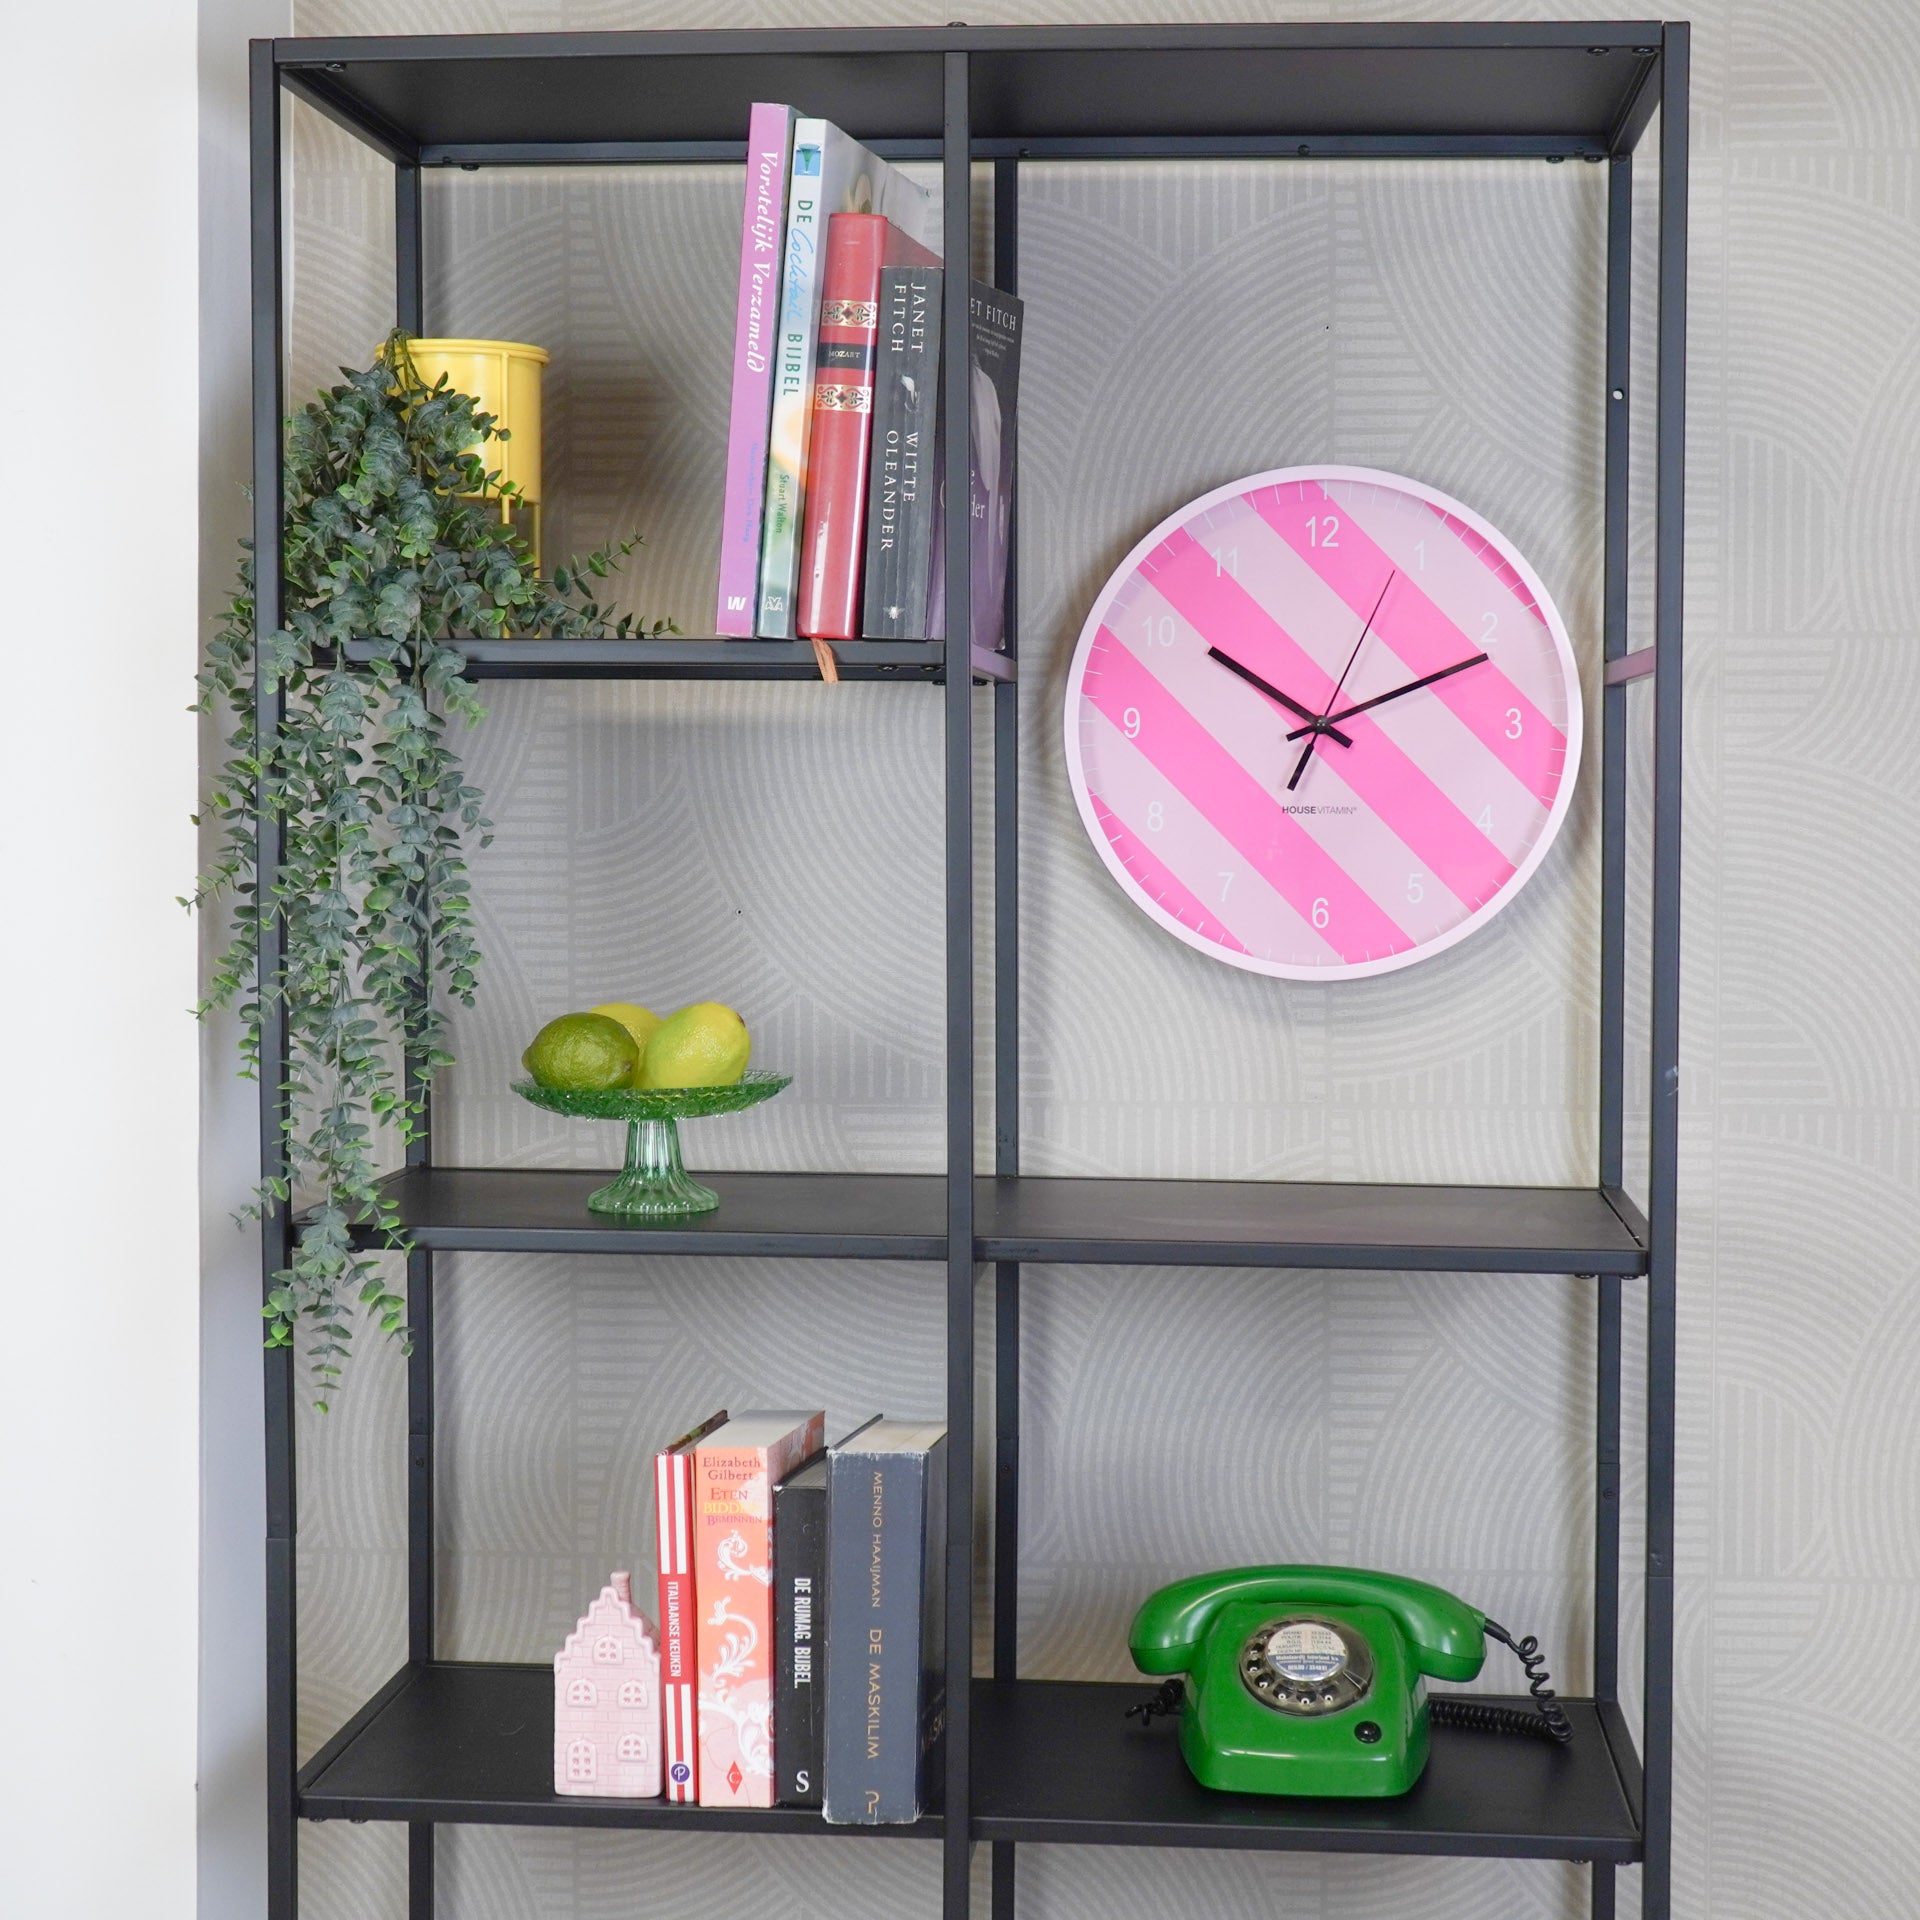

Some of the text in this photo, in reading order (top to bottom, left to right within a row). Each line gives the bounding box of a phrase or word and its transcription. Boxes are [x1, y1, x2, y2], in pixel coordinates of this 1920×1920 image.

[751, 152, 778, 252] Vorstelijk
[796, 200, 813, 223] DE
[891, 284, 907, 352] FITCH
[911, 282, 926, 353] JANET
[986, 304, 1017, 331] FITCH
[783, 333, 803, 396] BIJBEL
[828, 350, 861, 359] MOZART
[903, 431, 919, 502] WITTE
[775, 474, 790, 533] Stuart Walton
[880, 430, 899, 551] OLEANDER
[1305, 516, 1340, 548] 12
[1210, 545, 1238, 578] 11
[1413, 540, 1424, 571] 1
[1142, 616, 1176, 648] 10
[1481, 612, 1499, 643] 2
[1123, 707, 1141, 739] 9
[1505, 708, 1523, 740] 3
[1147, 801, 1164, 832] 8
[1476, 803, 1493, 835] 4
[1218, 871, 1235, 902] 7
[1406, 873, 1424, 904] 5
[1312, 897, 1329, 929] 6
[703, 1456, 761, 1468] Elizabeth
[708, 1469, 753, 1480] Gilbert
[872, 1471, 883, 1528] MENNO
[794, 1577, 811, 1593] DE
[667, 1581, 681, 1678] ITALIAANSE KEUKEN
[867, 1629, 882, 1759] DE MASKILIM
[796, 1771, 810, 1793] S
